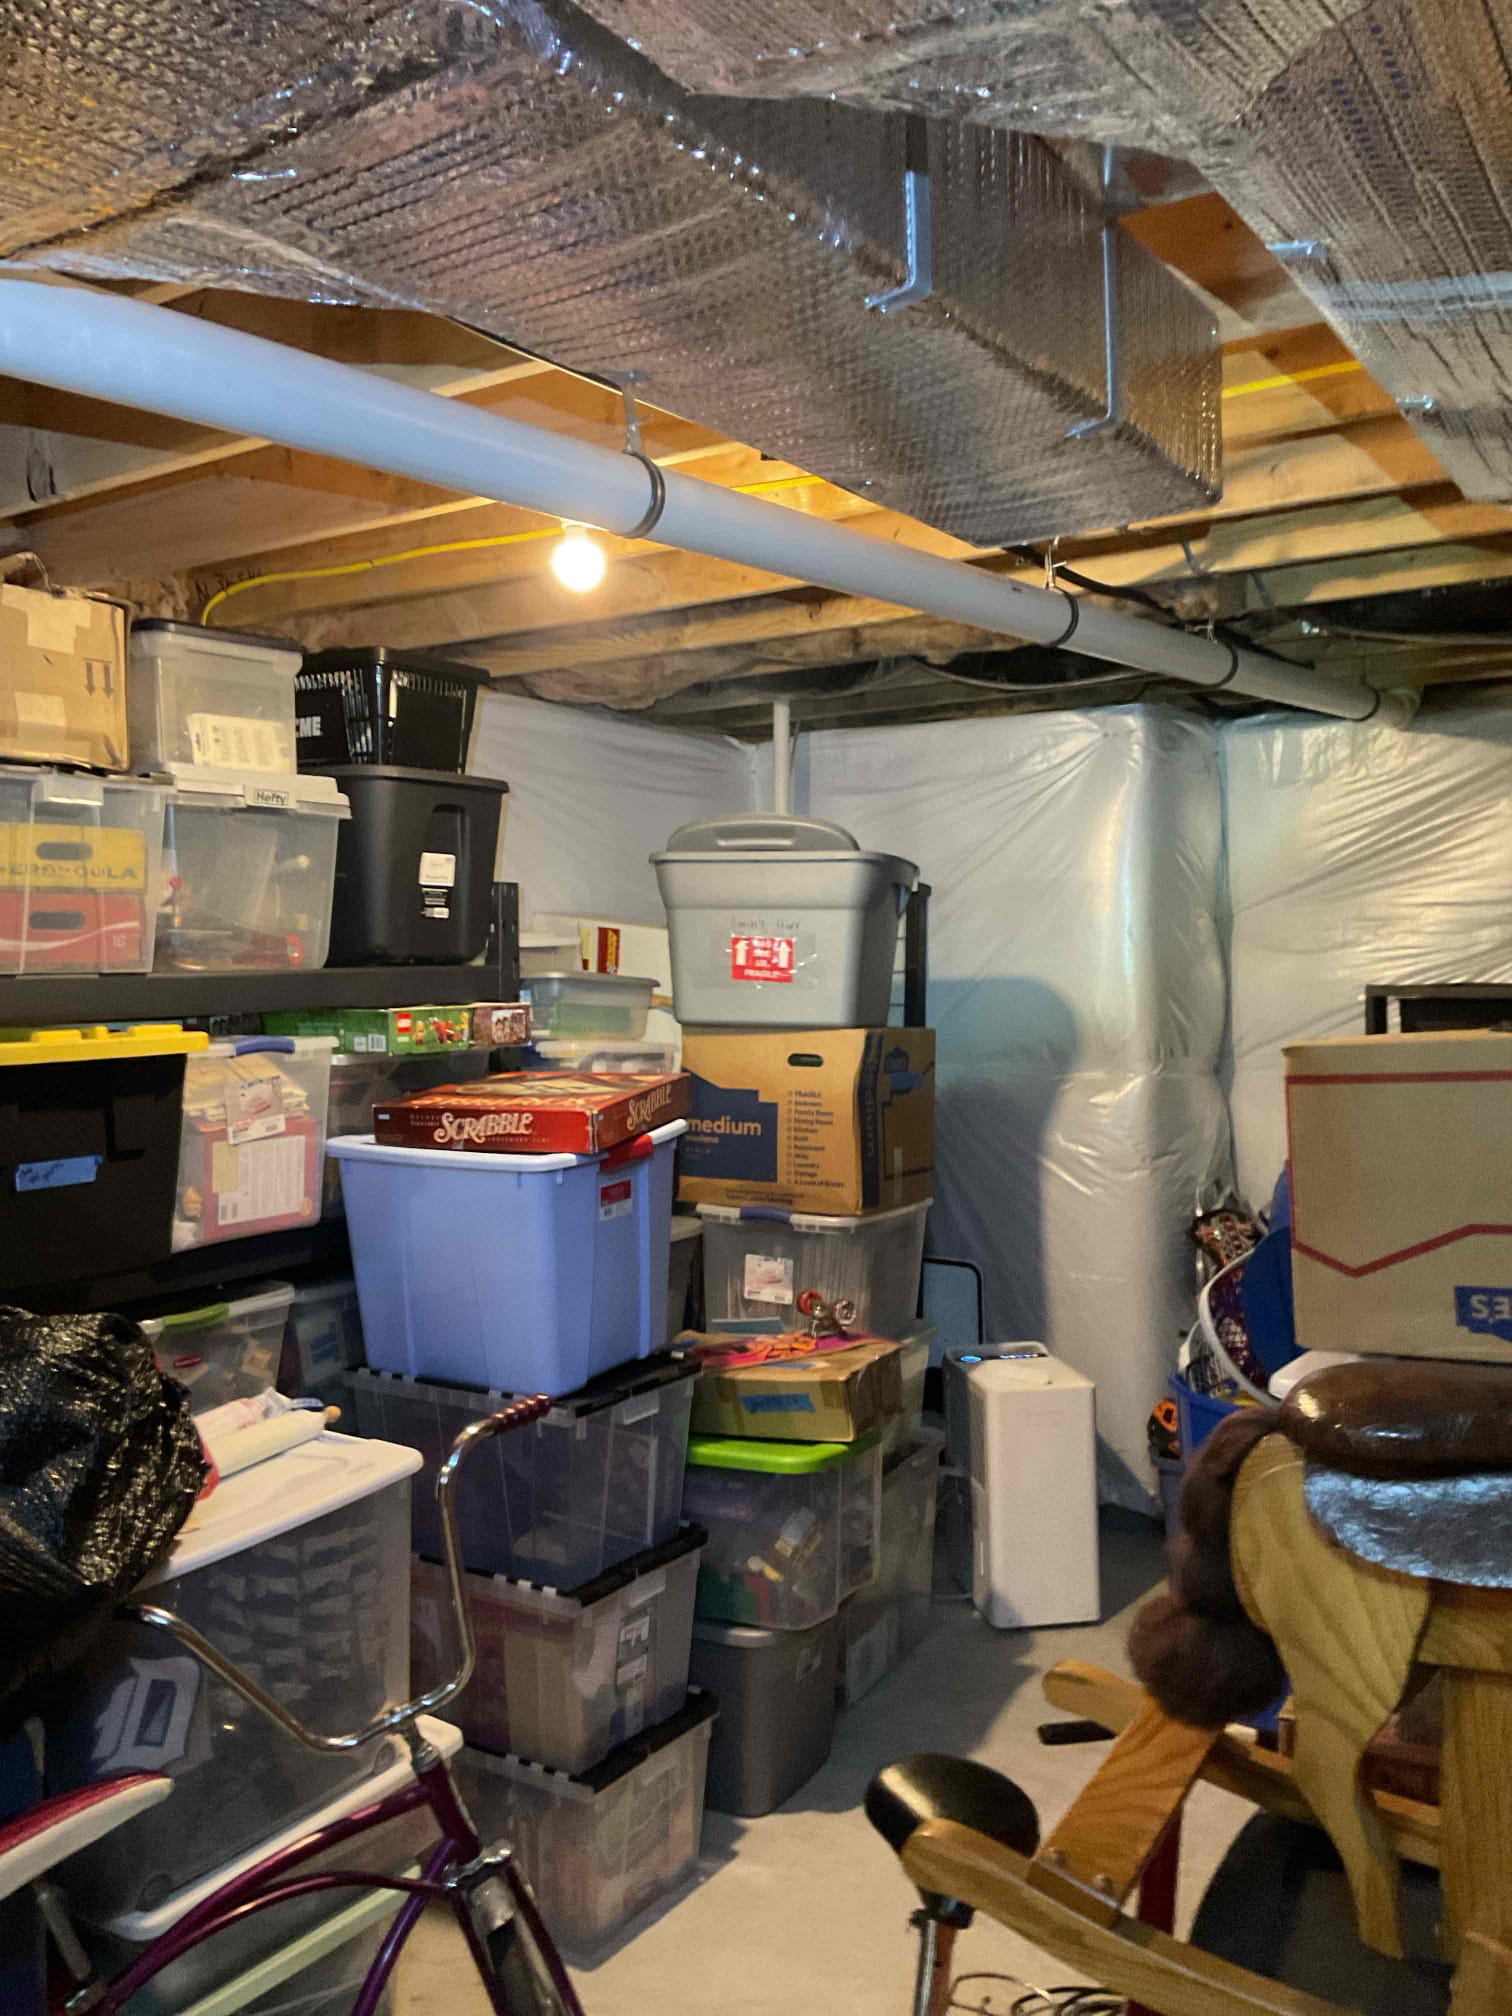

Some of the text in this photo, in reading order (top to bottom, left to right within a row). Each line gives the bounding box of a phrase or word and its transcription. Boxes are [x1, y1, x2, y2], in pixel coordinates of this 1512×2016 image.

[256, 790, 286, 806] Hefty
[626, 1083, 672, 1132] SCRABBLE
[433, 1111, 534, 1144] SCRABBLE
[686, 1114, 762, 1136] medium
